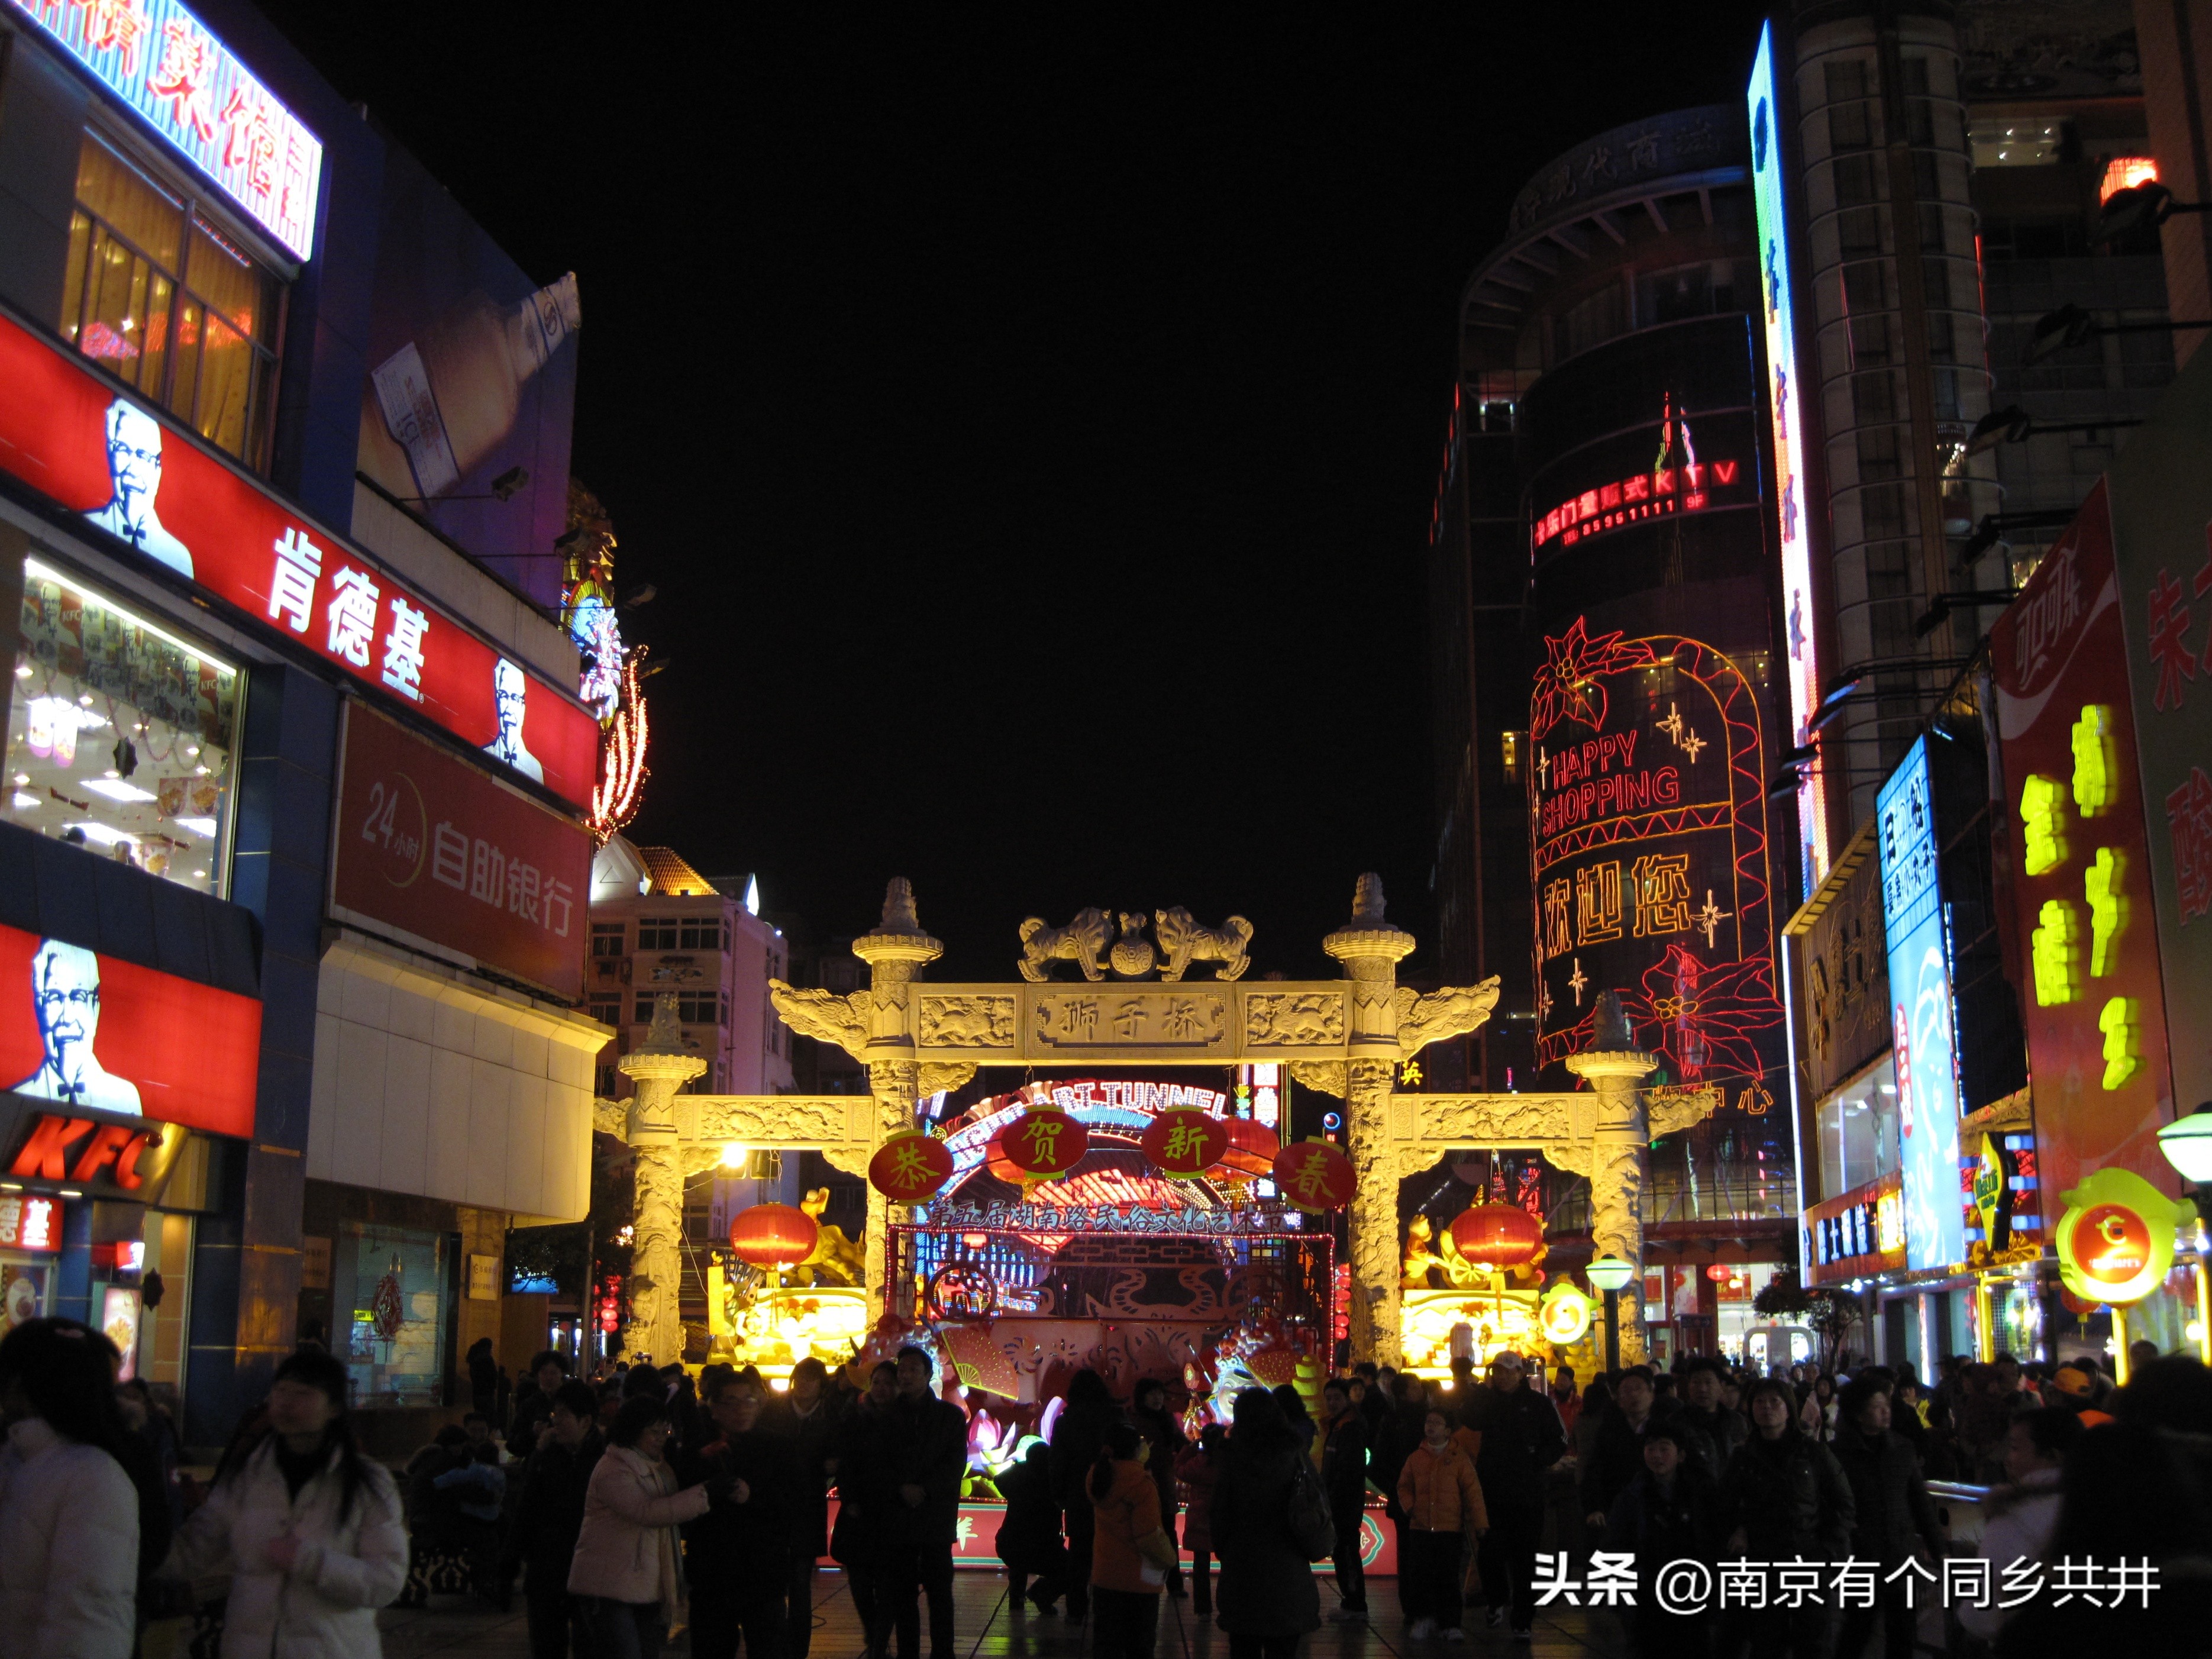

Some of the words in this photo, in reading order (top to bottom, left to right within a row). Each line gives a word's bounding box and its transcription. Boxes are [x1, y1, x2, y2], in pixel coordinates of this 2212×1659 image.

[35, 0, 276, 198] 情菜馆
[62, 609, 81, 622] KFC
[269, 527, 430, 701] 肯德基
[2014, 537, 2081, 691] 可口可乐
[201, 679, 217, 690] KFC
[1552, 730, 1638, 790] HAPPY
[1542, 766, 1680, 838] SHOPPING
[1544, 854, 1691, 959] 欢迎您
[1058, 999, 1205, 1042] 狮子桥
[9, 1115, 155, 1190] KFC
[948, 1101, 1024, 1177] IGHT
[1100, 1082, 1229, 1121] TUNNEL
[925, 1198, 1286, 1234] 第五届湖南路民俗文化艺术节
